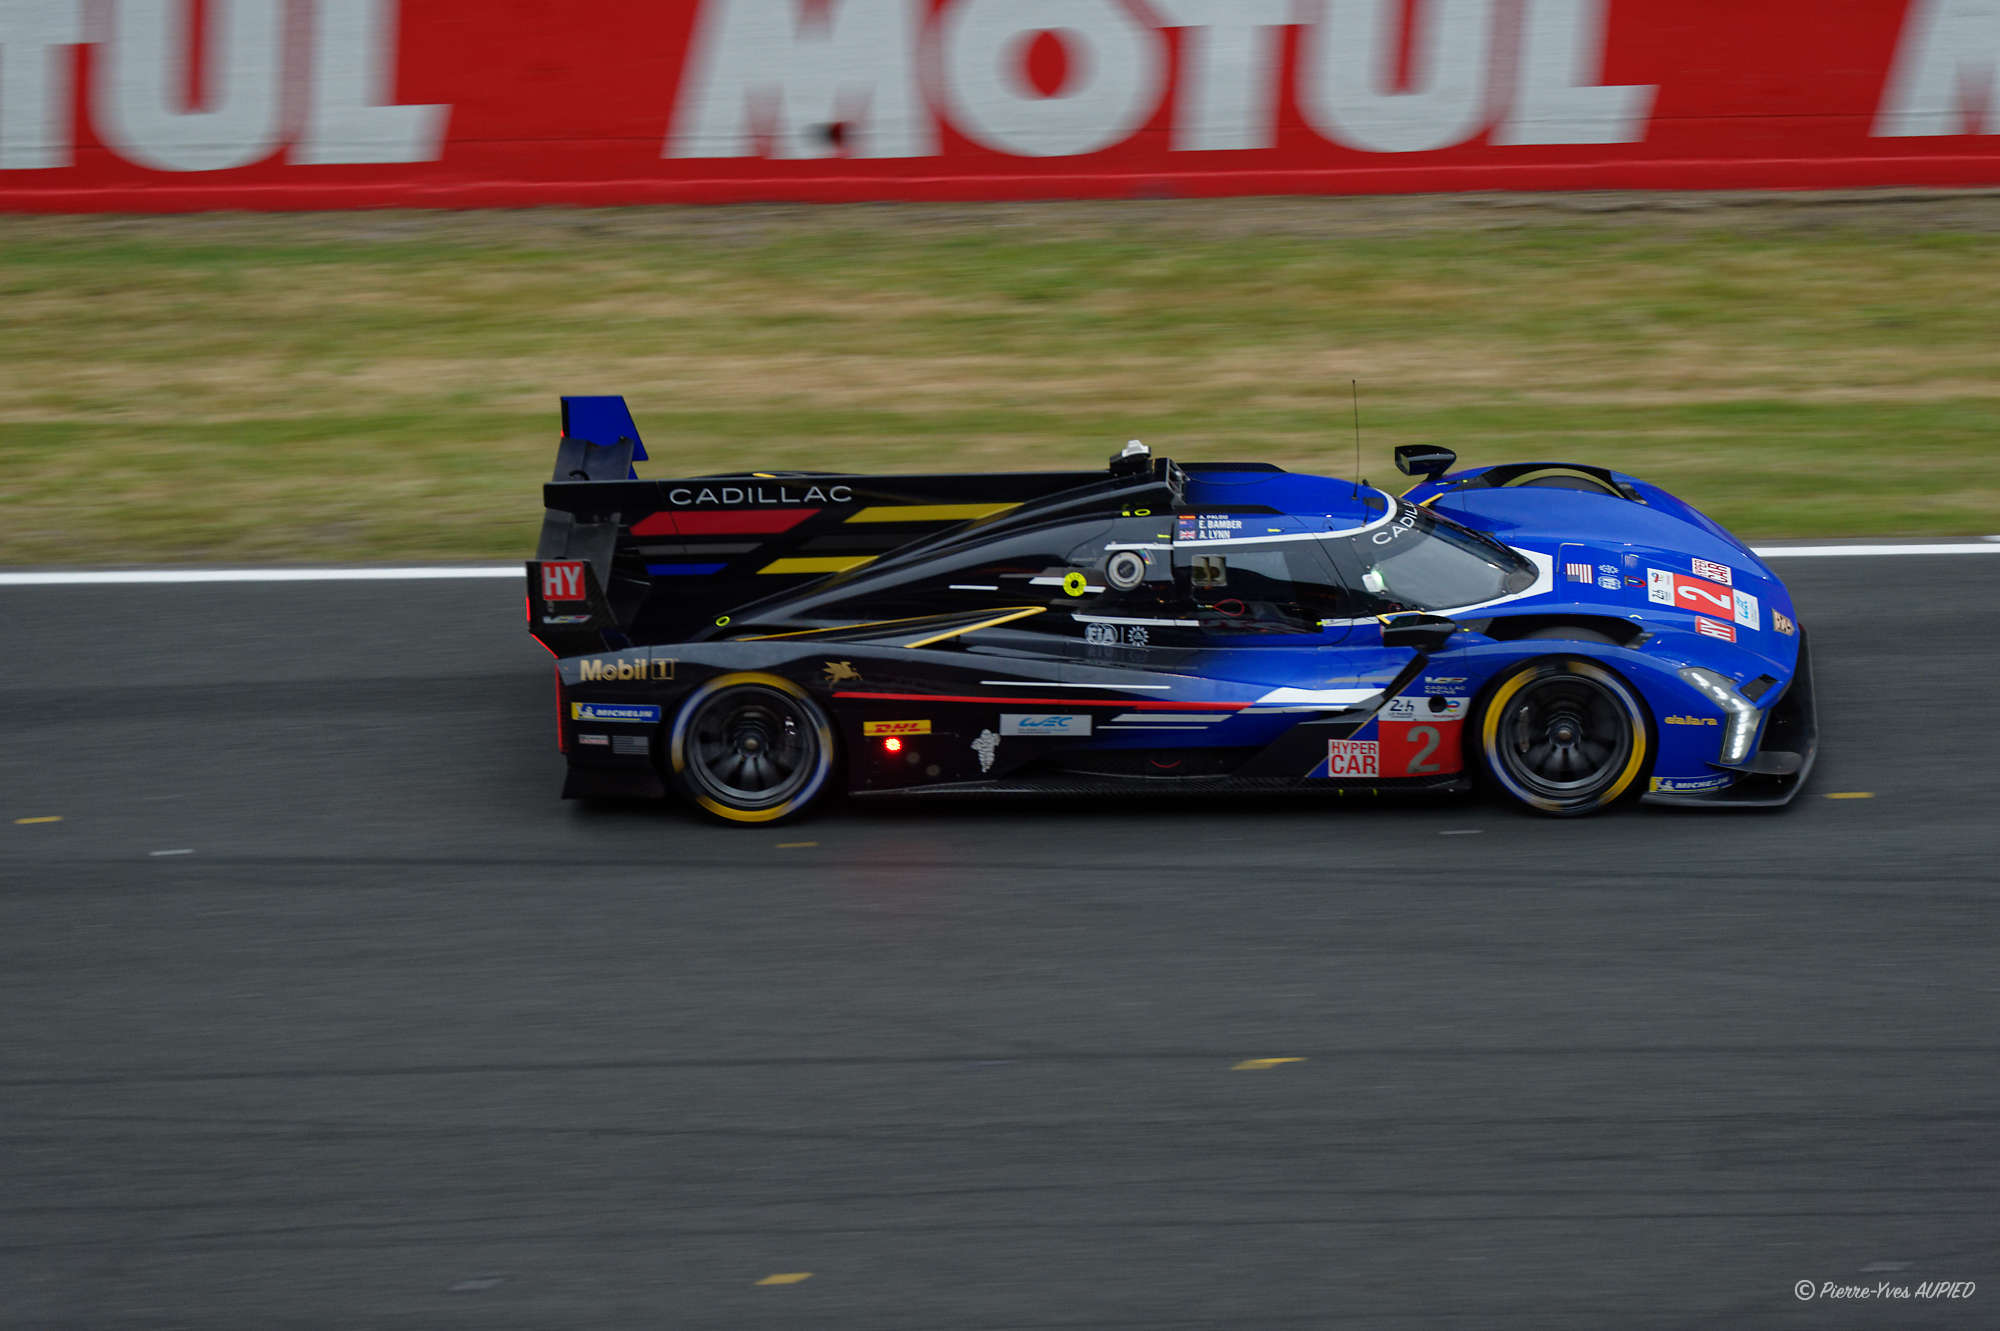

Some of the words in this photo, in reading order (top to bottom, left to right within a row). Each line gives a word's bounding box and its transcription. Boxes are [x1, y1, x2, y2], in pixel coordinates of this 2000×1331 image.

[660, 0, 1660, 158] MOTUL
[668, 485, 853, 506] CADILLAC
[1207, 520, 1242, 529] BAMBER
[1208, 529, 1231, 539] LYNN
[543, 566, 580, 596] HY
[1708, 563, 1728, 583] CAR
[1677, 585, 1732, 610] 2
[1086, 625, 1117, 644] FIA
[1700, 618, 1732, 641] HY
[580, 658, 648, 681] Mobil
[596, 709, 654, 718] MICHELIN
[1018, 716, 1073, 728] WEC
[873, 722, 921, 733] DHL
[1330, 741, 1377, 755] HYPER
[1405, 725, 1441, 774] 2
[1330, 754, 1377, 774] CAR
[1674, 776, 1729, 789] MICHELIN
